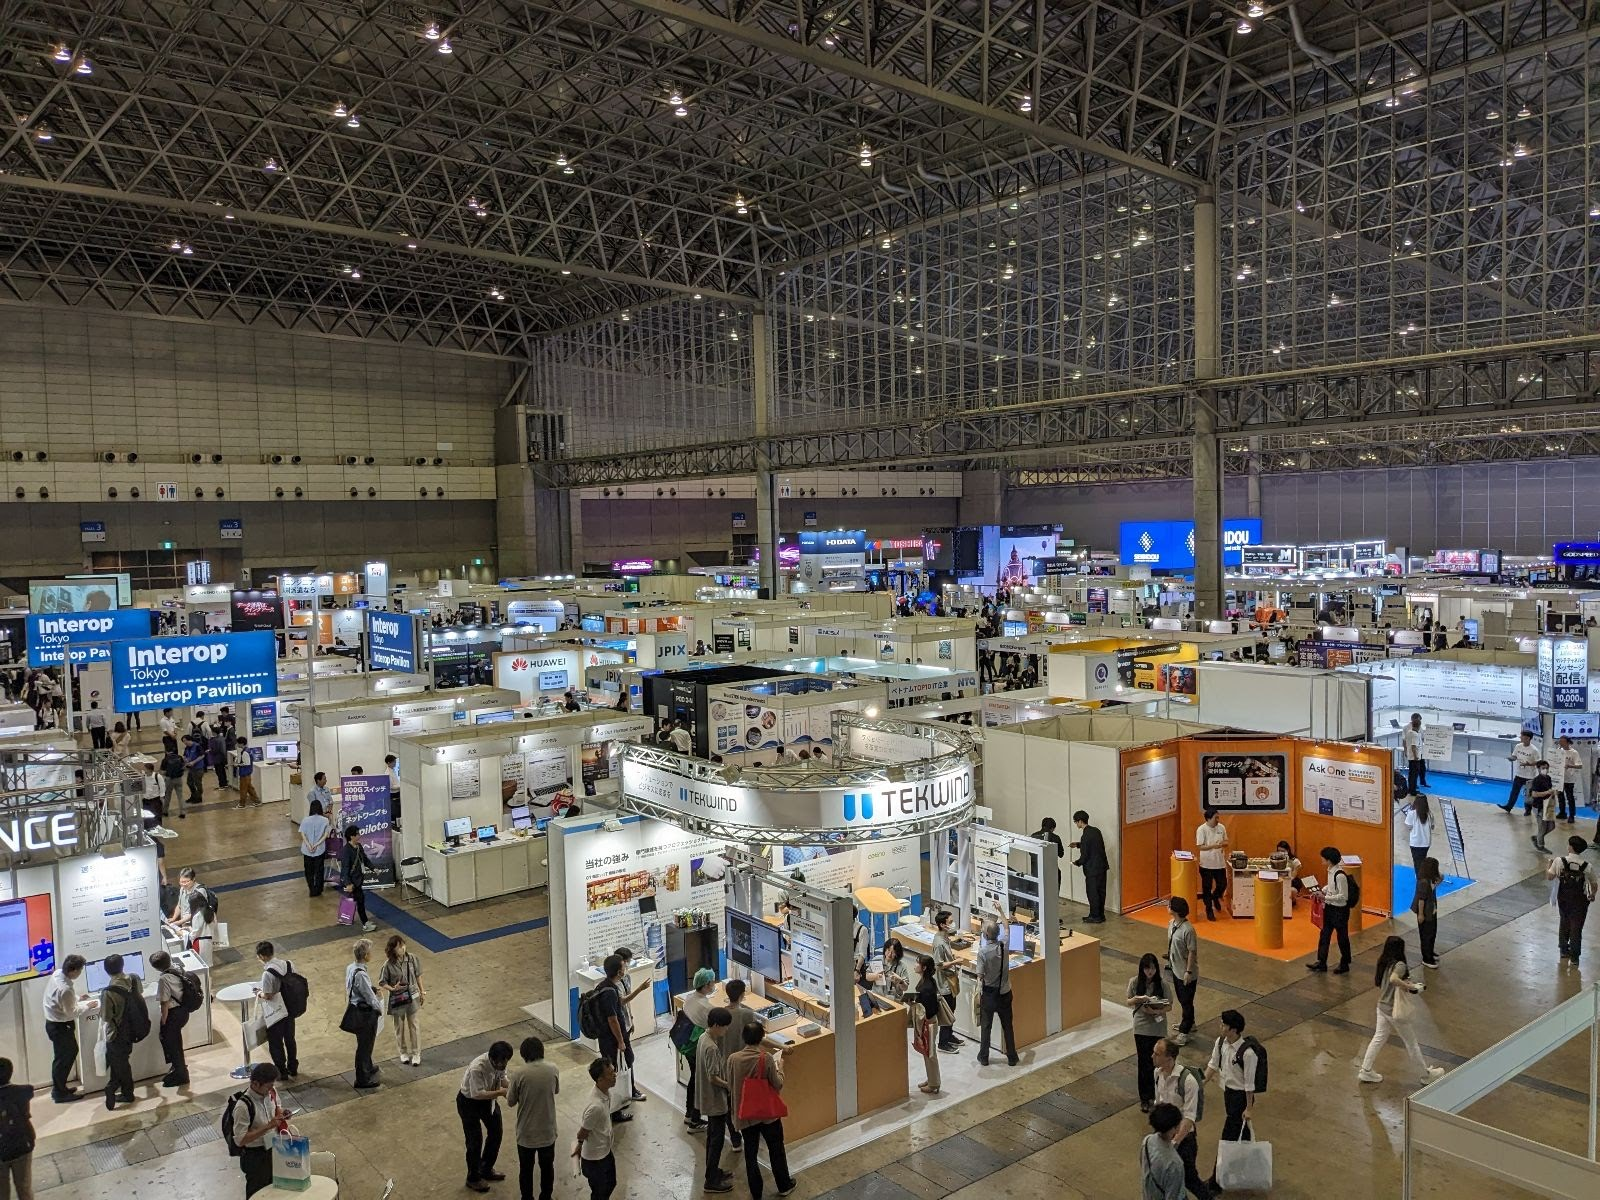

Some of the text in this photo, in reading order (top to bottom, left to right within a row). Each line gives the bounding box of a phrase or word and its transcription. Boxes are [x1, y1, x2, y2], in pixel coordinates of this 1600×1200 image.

[39, 618, 113, 634] Interop
[372, 616, 399, 638] Interop
[40, 634, 70, 645] Tokyo
[372, 633, 384, 646] Tokyo
[40, 651, 87, 662] Inteop
[128, 643, 228, 668] Interop
[658, 644, 686, 657] JPIX
[373, 651, 410, 668] Interop Pavilion
[530, 657, 566, 669] HUAWEI
[130, 667, 170, 681] Tokyo
[605, 670, 622, 683] JPIX
[957, 676, 976, 688] NTQ
[131, 682, 262, 706] Interop Pavilion
[1308, 762, 1326, 774] Ask
[1327, 765, 1346, 777] One
[689, 790, 737, 812] TEKWIND
[882, 772, 970, 817] TEKWIND
[585, 852, 630, 870] 当社の強み
